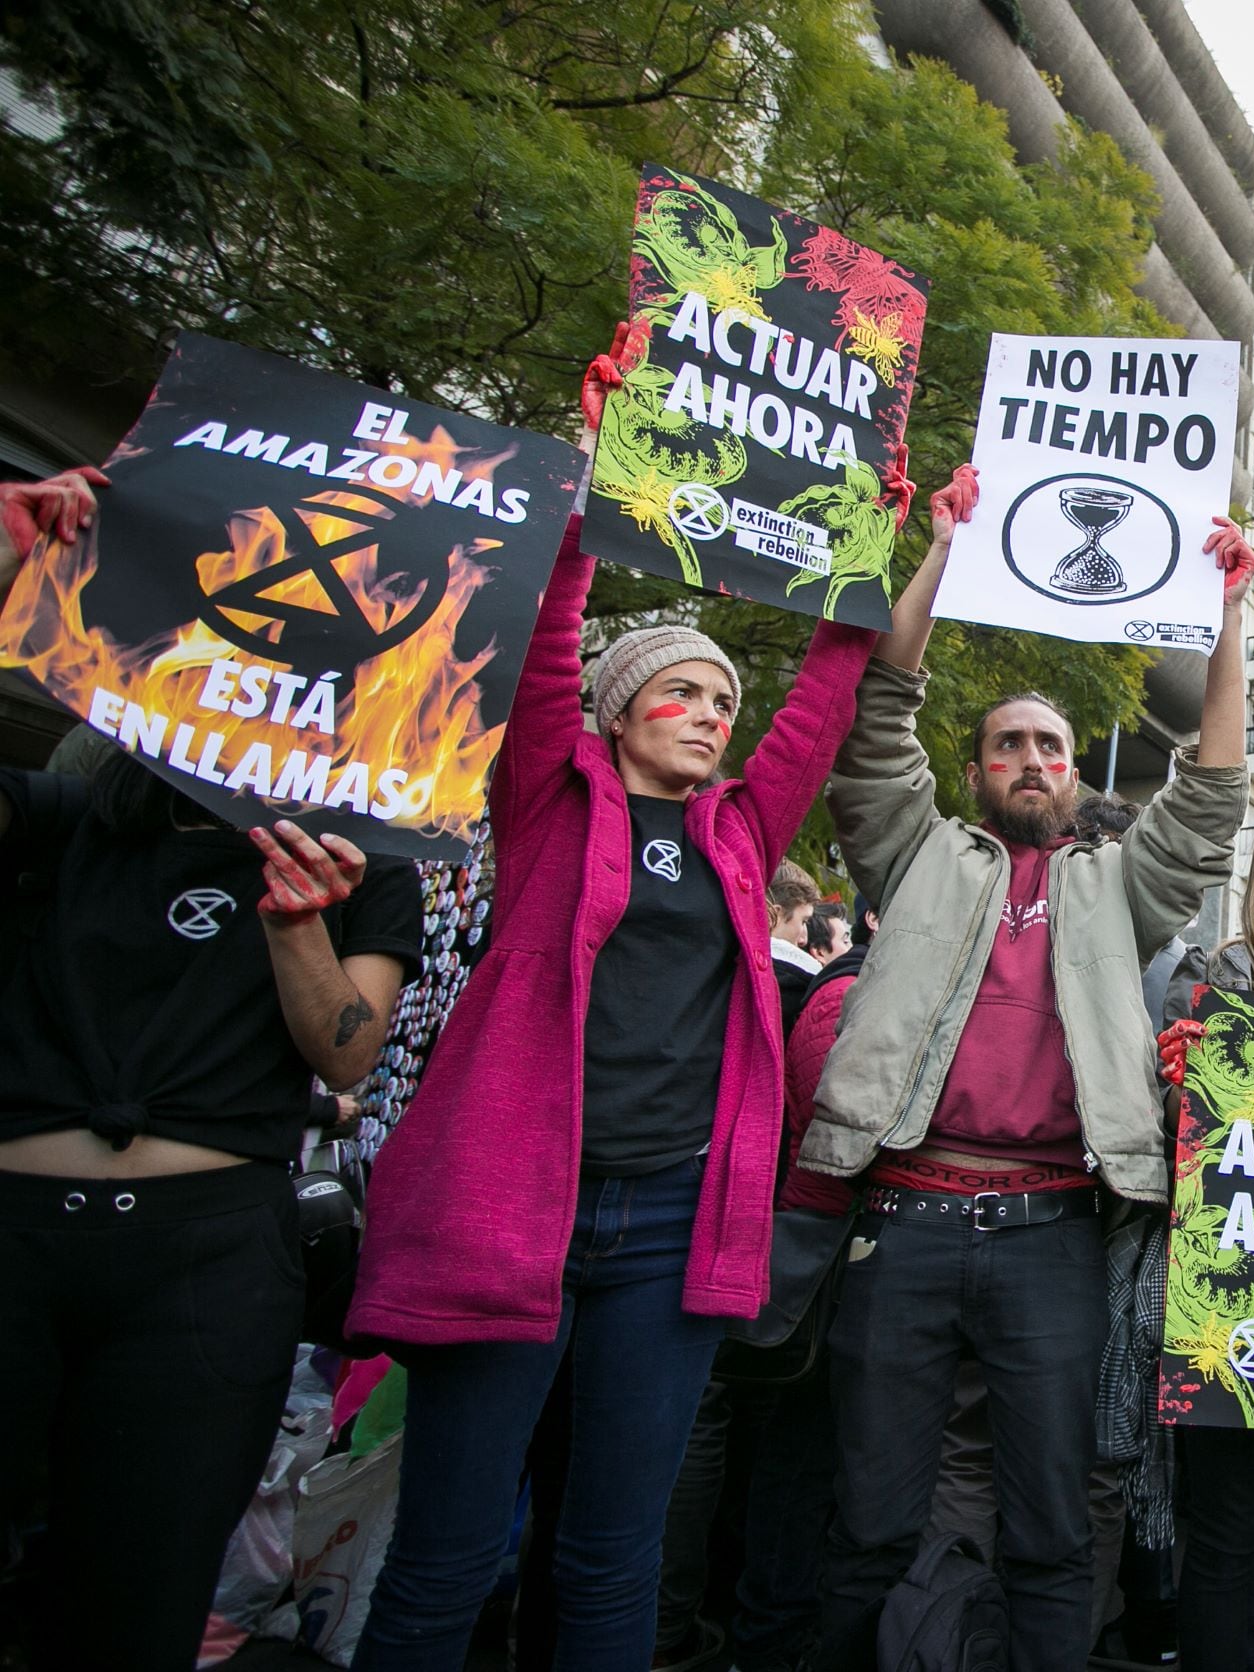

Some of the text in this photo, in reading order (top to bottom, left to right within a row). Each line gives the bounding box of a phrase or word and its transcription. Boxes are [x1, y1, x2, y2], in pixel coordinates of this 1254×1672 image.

[667, 291, 877, 420] ACTUAR
[1026, 349, 1199, 397] NO HAY
[352, 401, 409, 445] EL
[664, 362, 858, 470] AHORA
[999, 397, 1216, 471] TIEMPO
[173, 421, 530, 524] AMAZONAS
[737, 507, 814, 544] extinction
[758, 536, 827, 571] rebellion
[1158, 624, 1205, 634] extinction
[1171, 633, 1213, 647] rebellion
[198, 658, 342, 735] ESTÁ
[888, 1152, 1067, 1188] MOTOR OIL
